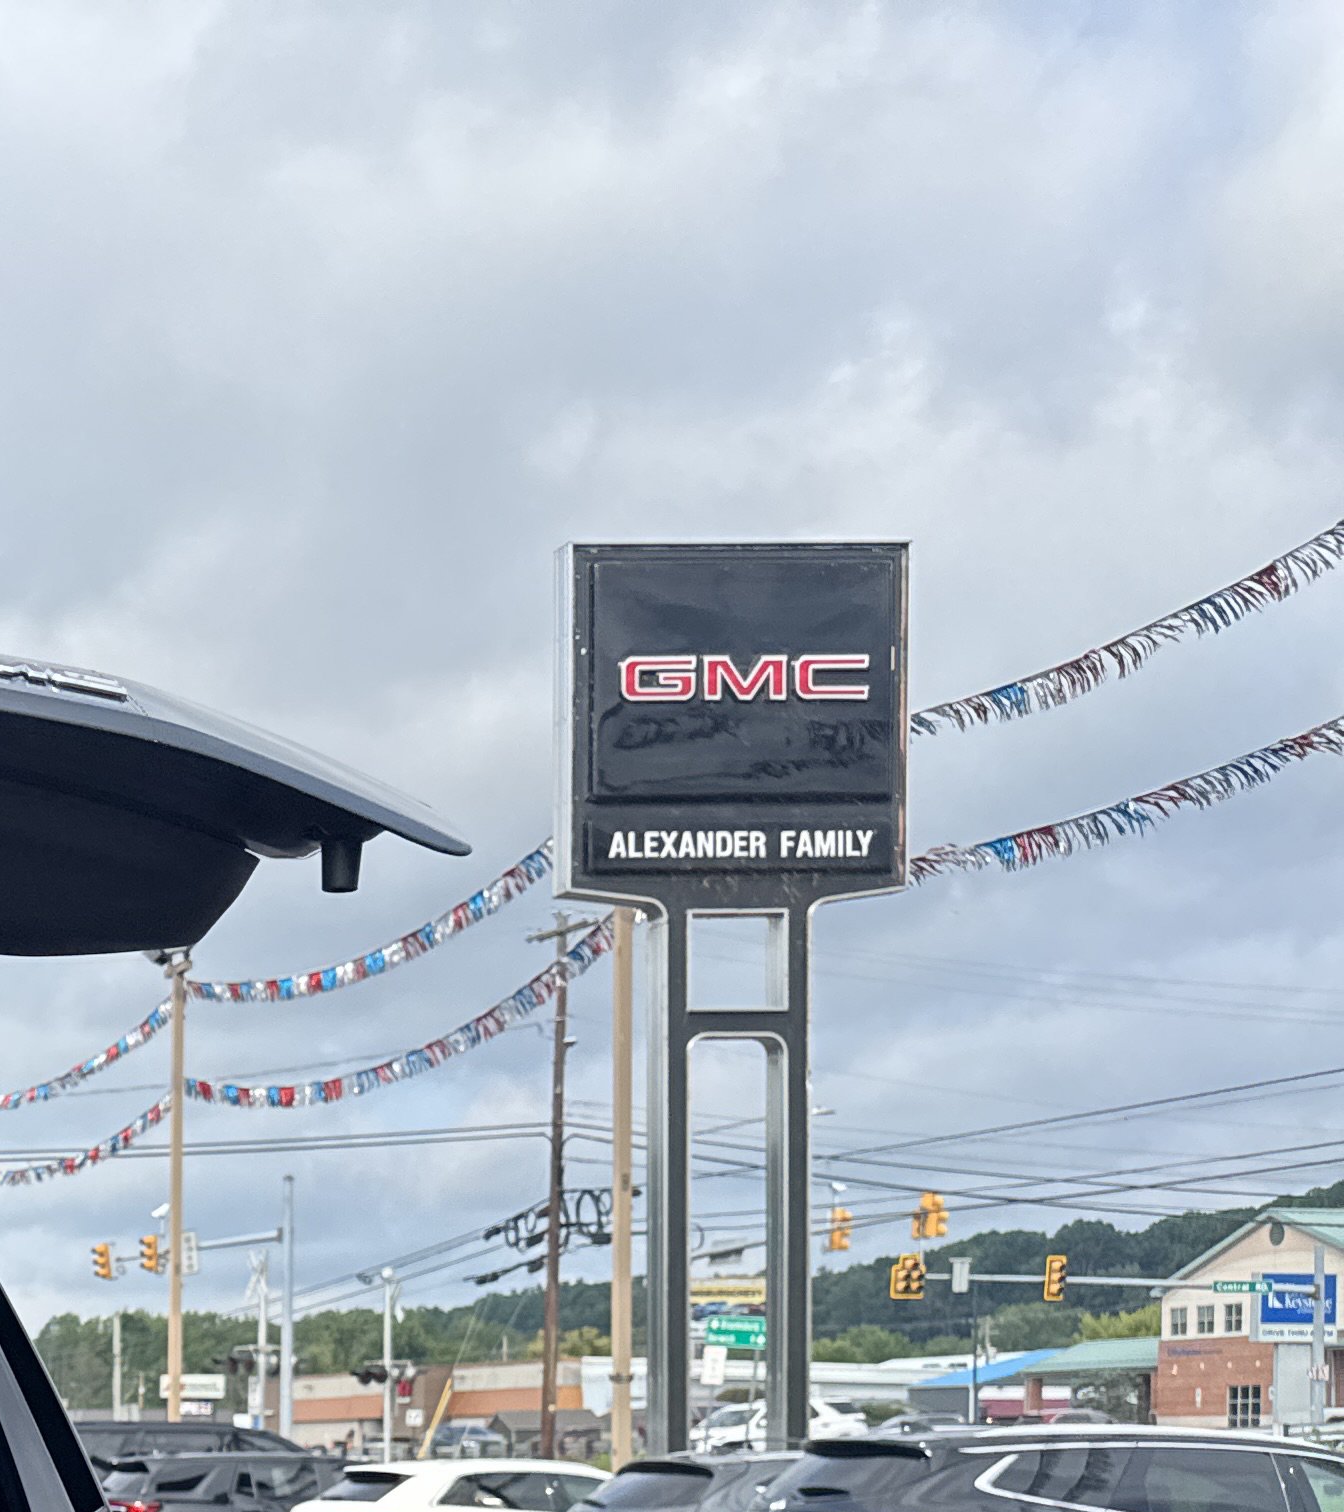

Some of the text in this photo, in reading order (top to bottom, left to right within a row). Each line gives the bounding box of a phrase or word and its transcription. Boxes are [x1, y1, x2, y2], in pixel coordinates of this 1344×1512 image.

[619, 654, 870, 701] GMC
[608, 830, 874, 858] ALEXANDER FAMILY
[1216, 1282, 1250, 1292] Central
